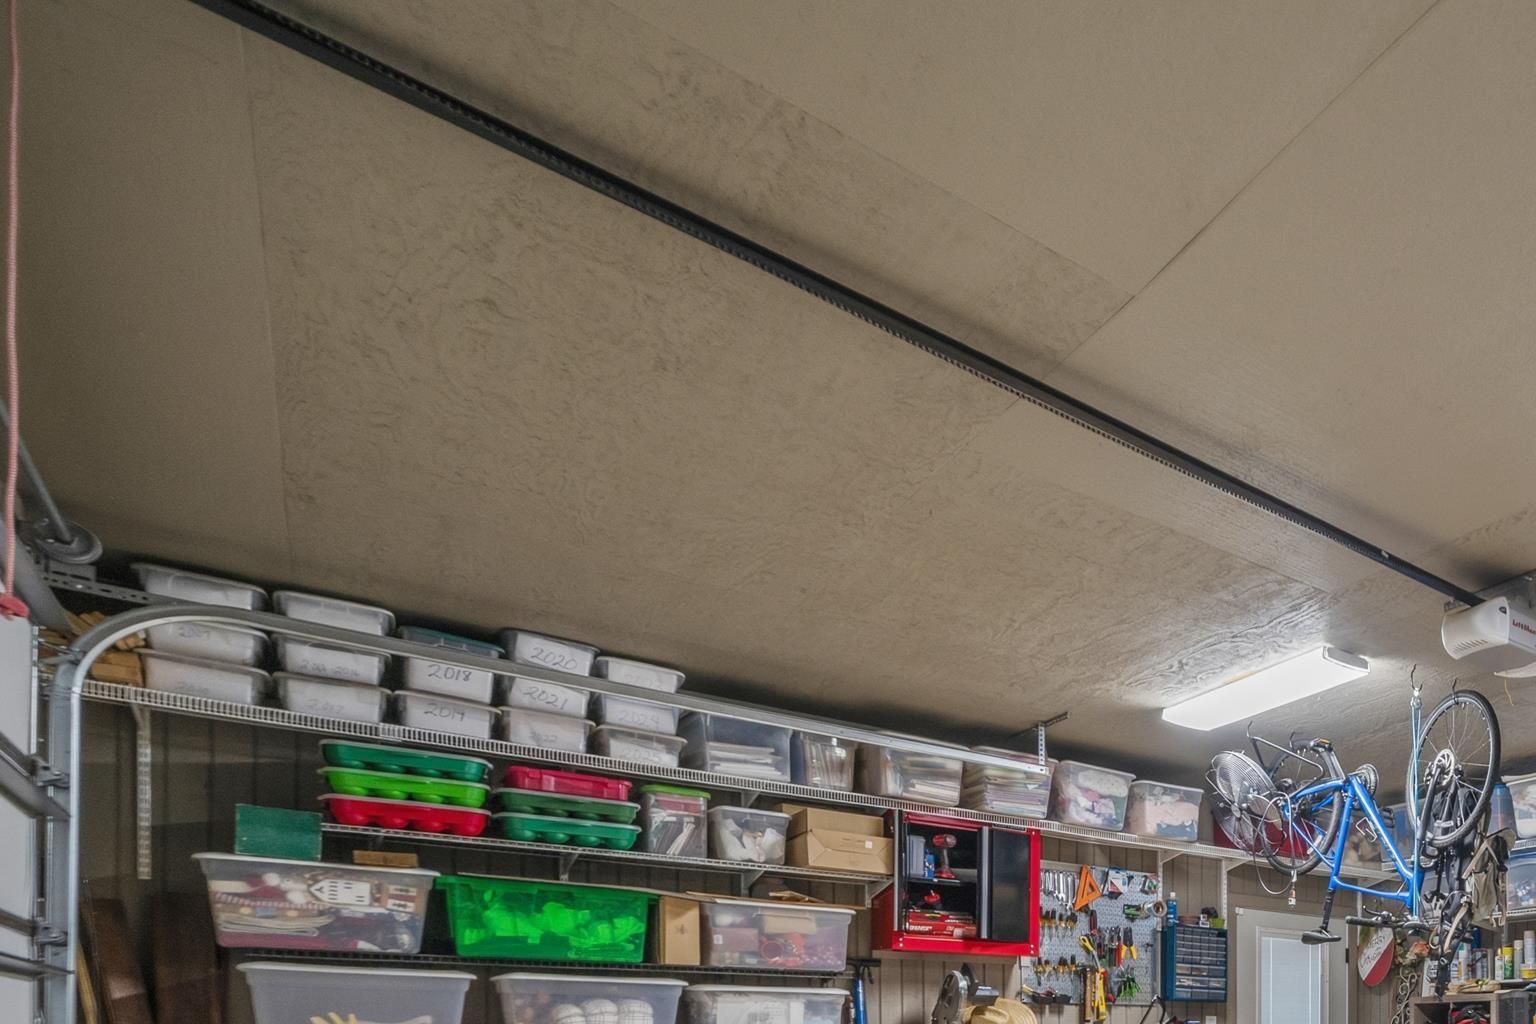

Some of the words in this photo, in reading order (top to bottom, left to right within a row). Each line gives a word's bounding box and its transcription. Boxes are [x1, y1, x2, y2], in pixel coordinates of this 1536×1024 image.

[530, 647, 578, 671] 2020
[428, 663, 472, 682] 2018
[523, 685, 569, 711] 2021
